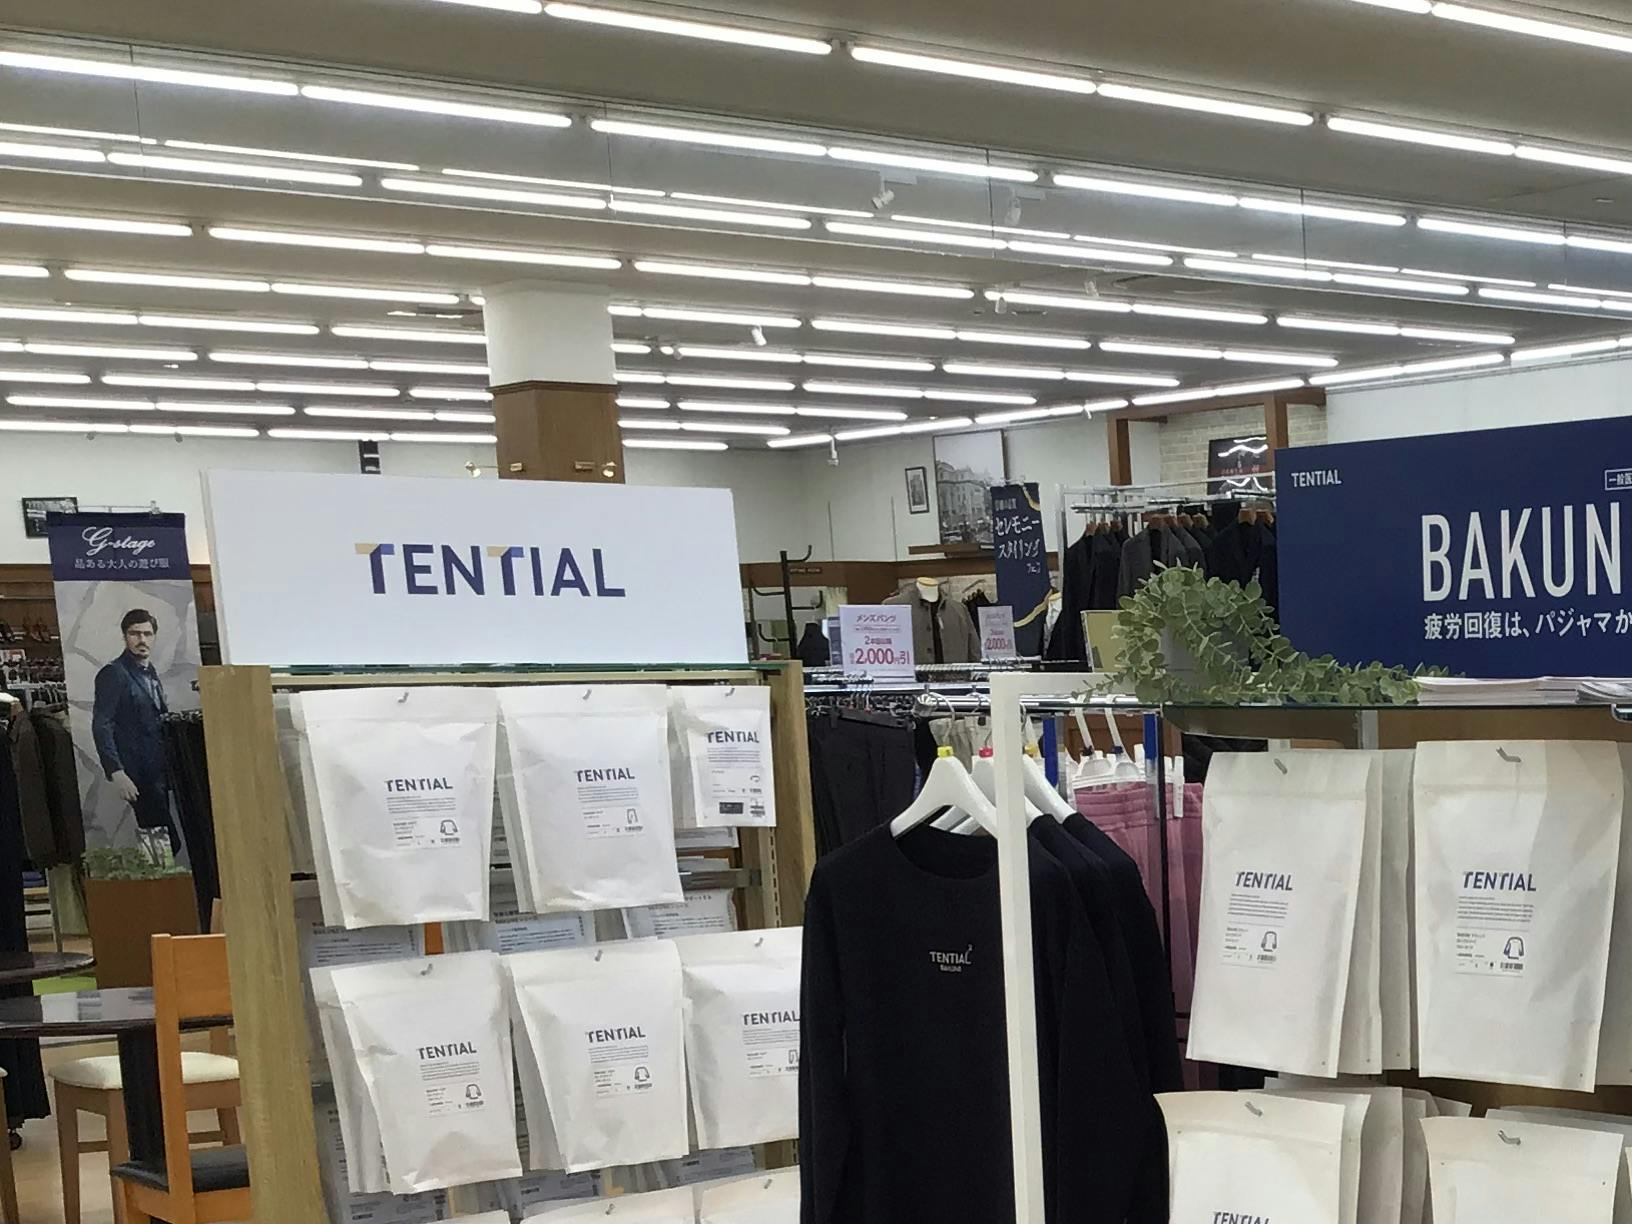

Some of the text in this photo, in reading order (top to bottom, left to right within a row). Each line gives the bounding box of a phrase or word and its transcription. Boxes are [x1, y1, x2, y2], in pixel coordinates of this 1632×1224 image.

[1290, 468, 1342, 488] TENTIAL
[354, 542, 626, 598] TENTIAL
[706, 730, 760, 744] TENTIAL
[575, 767, 636, 783] TENTIAL
[385, 777, 453, 793] TENTIAL
[1234, 870, 1294, 892] TENTIAL
[1463, 871, 1537, 891] TENTIAL
[929, 951, 971, 964] TENTIAL
[742, 1010, 800, 1026] TENTIAL
[585, 1025, 647, 1044] TENTIAL
[416, 1040, 478, 1060] TENTIAL
